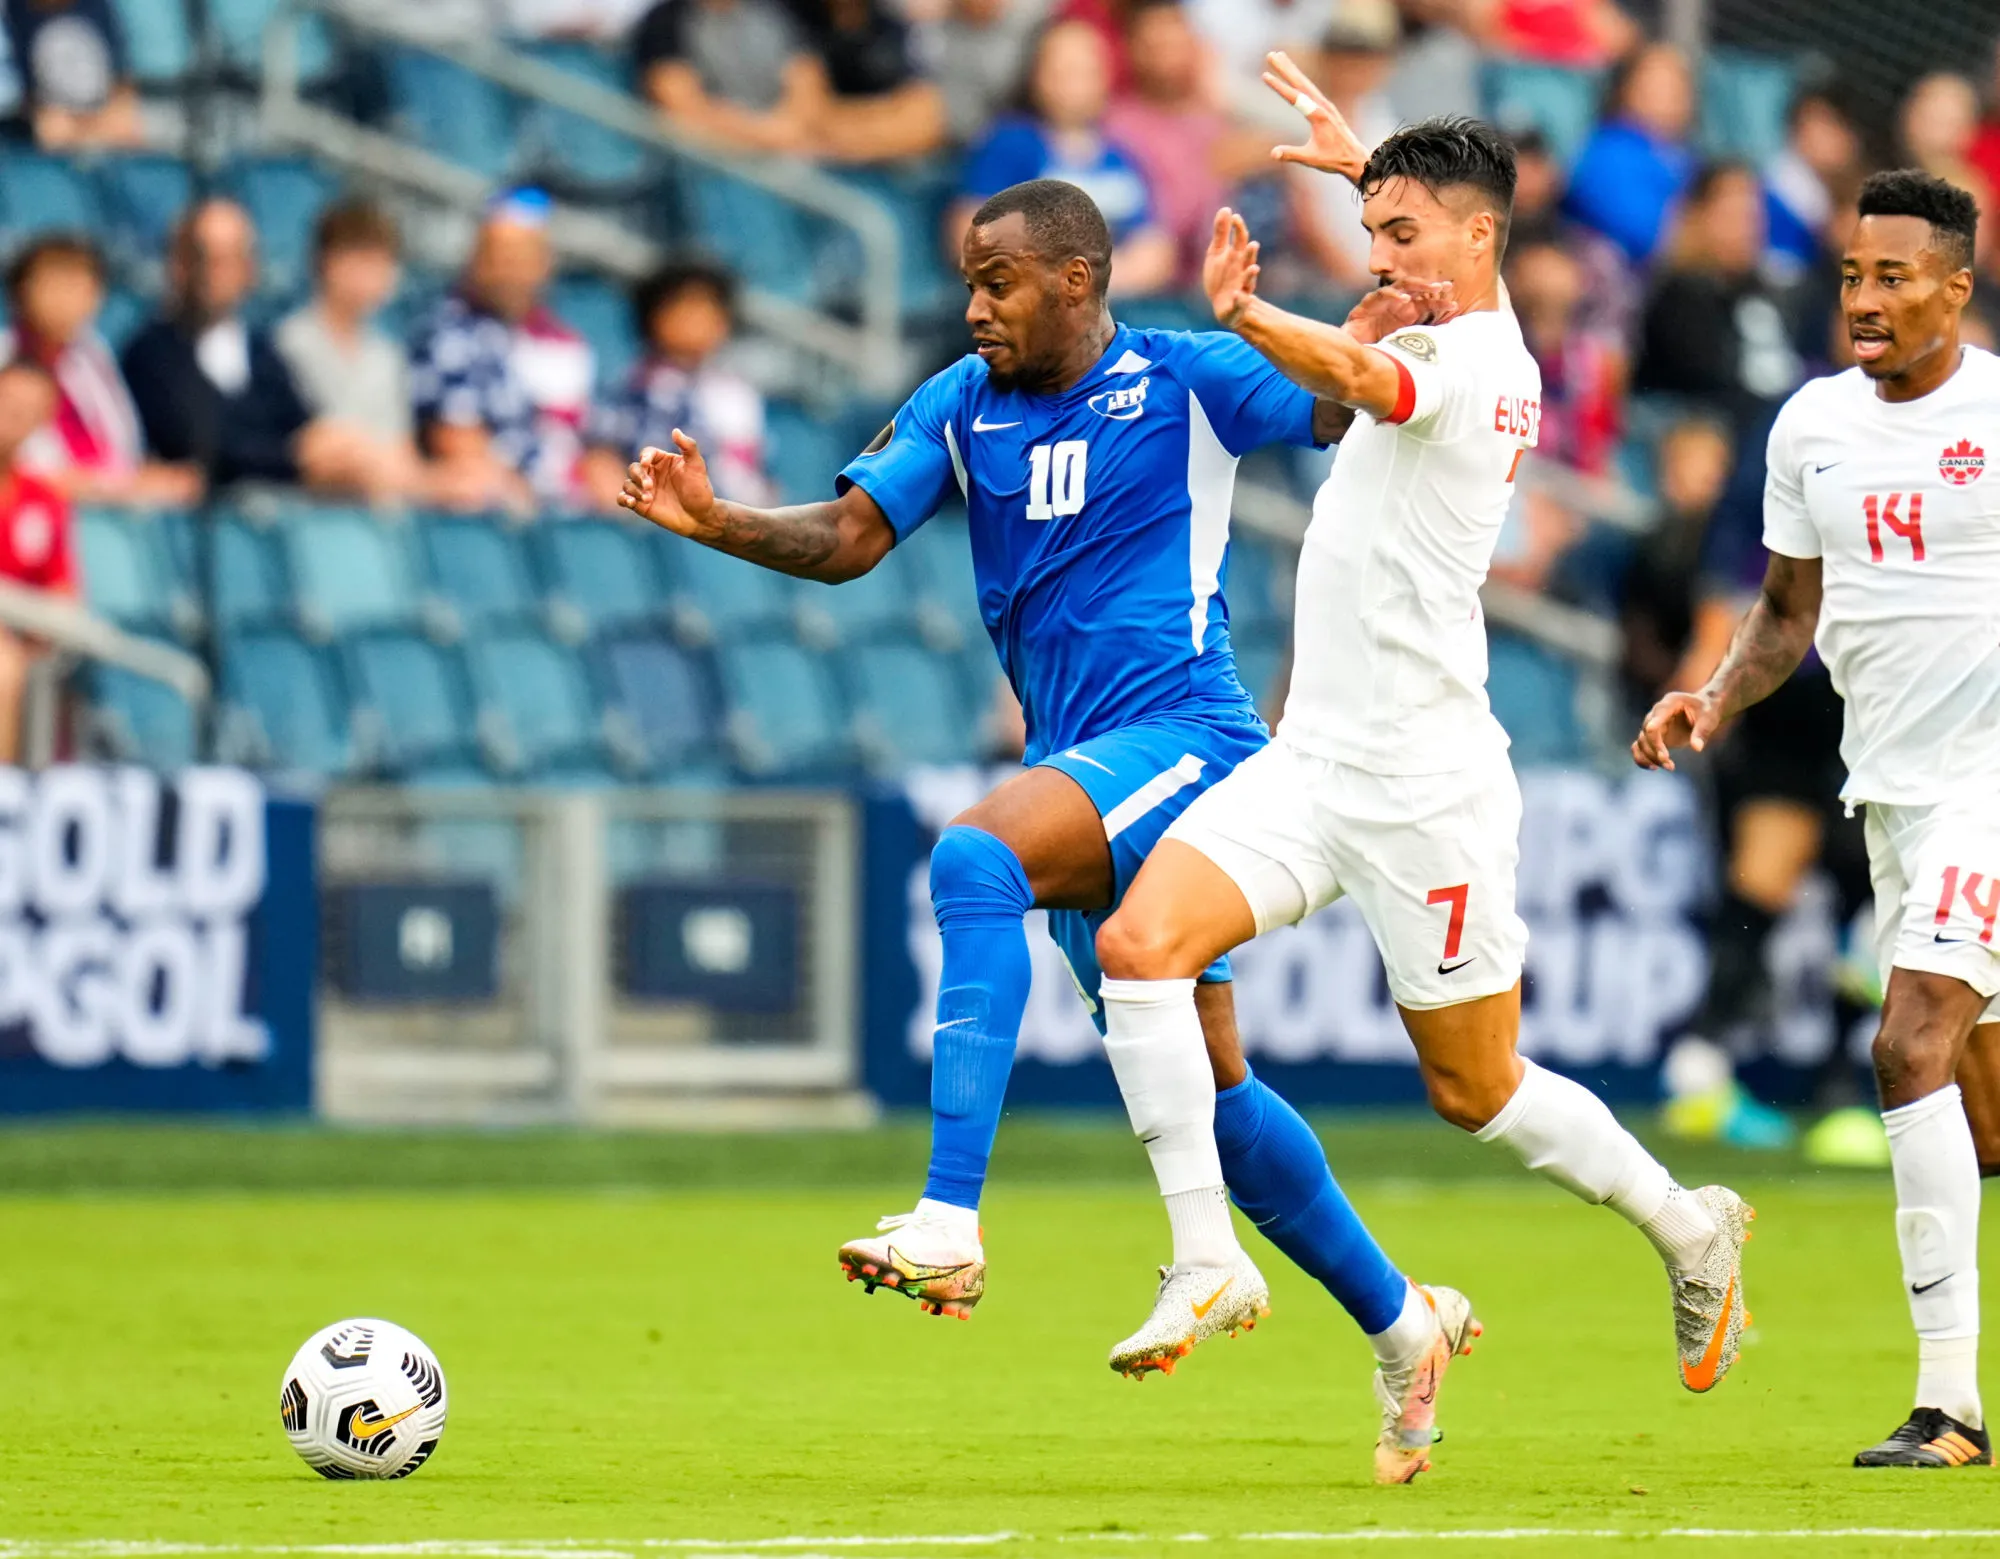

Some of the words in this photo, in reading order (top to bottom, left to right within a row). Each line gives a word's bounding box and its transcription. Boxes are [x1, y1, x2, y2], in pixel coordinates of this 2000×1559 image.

[1026, 440, 1088, 520] 10
[1938, 457, 1985, 467] CANADA
[1862, 493, 1925, 563] 14
[1426, 883, 1469, 959] 7
[1934, 866, 2000, 945] 14
